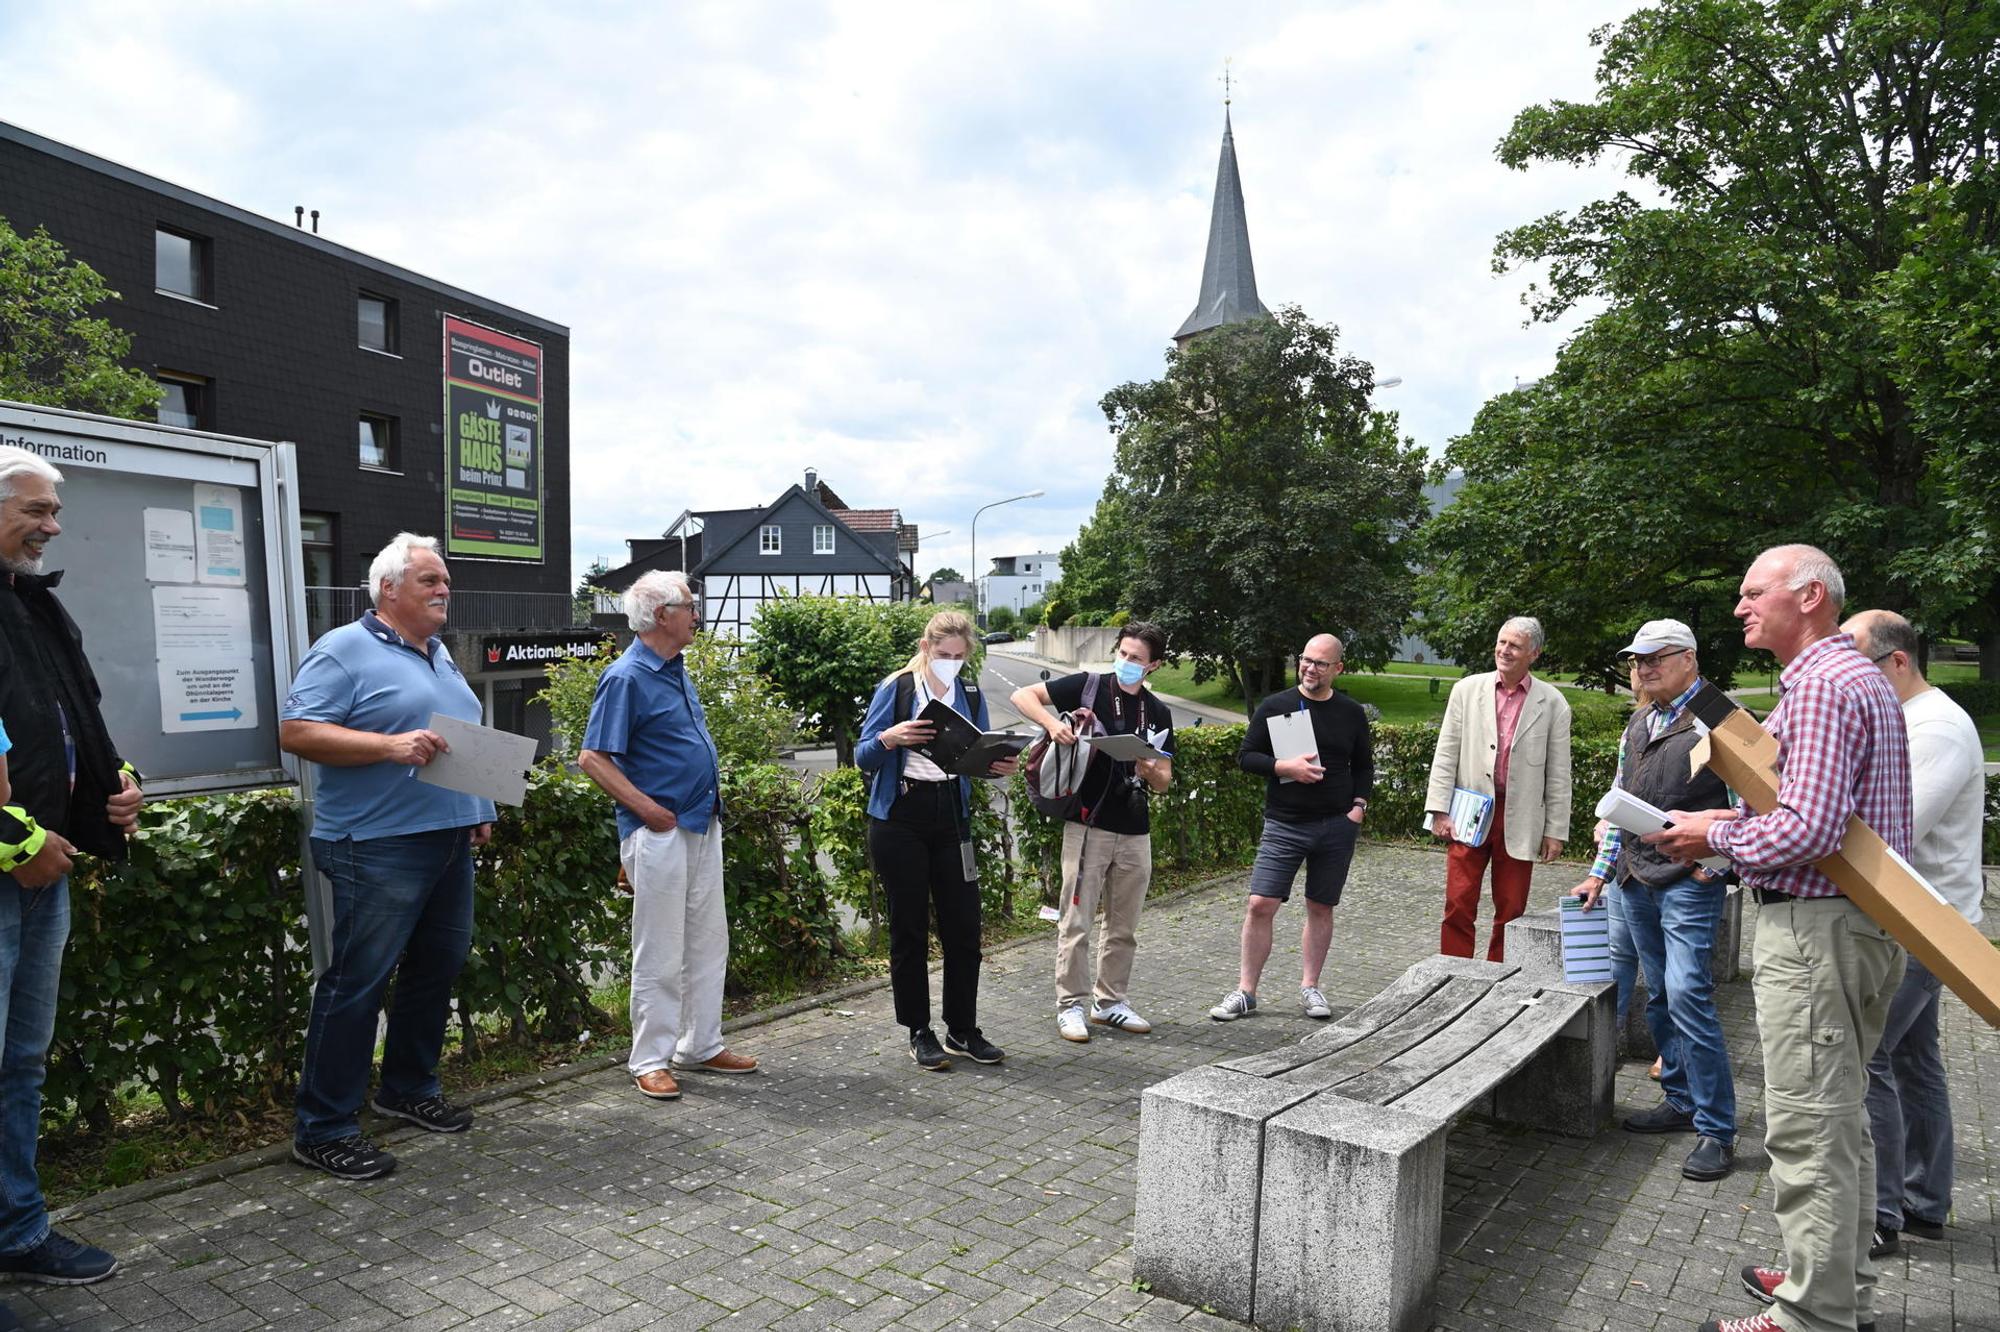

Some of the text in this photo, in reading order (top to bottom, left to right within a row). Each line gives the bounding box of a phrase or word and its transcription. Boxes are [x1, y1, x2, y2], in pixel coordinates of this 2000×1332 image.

[469, 358, 522, 388] Outlet
[460, 411, 501, 444] GÄSTE
[0, 434, 106, 463] Information
[460, 438, 502, 473] HAUS
[460, 467, 502, 487] beim Prinz
